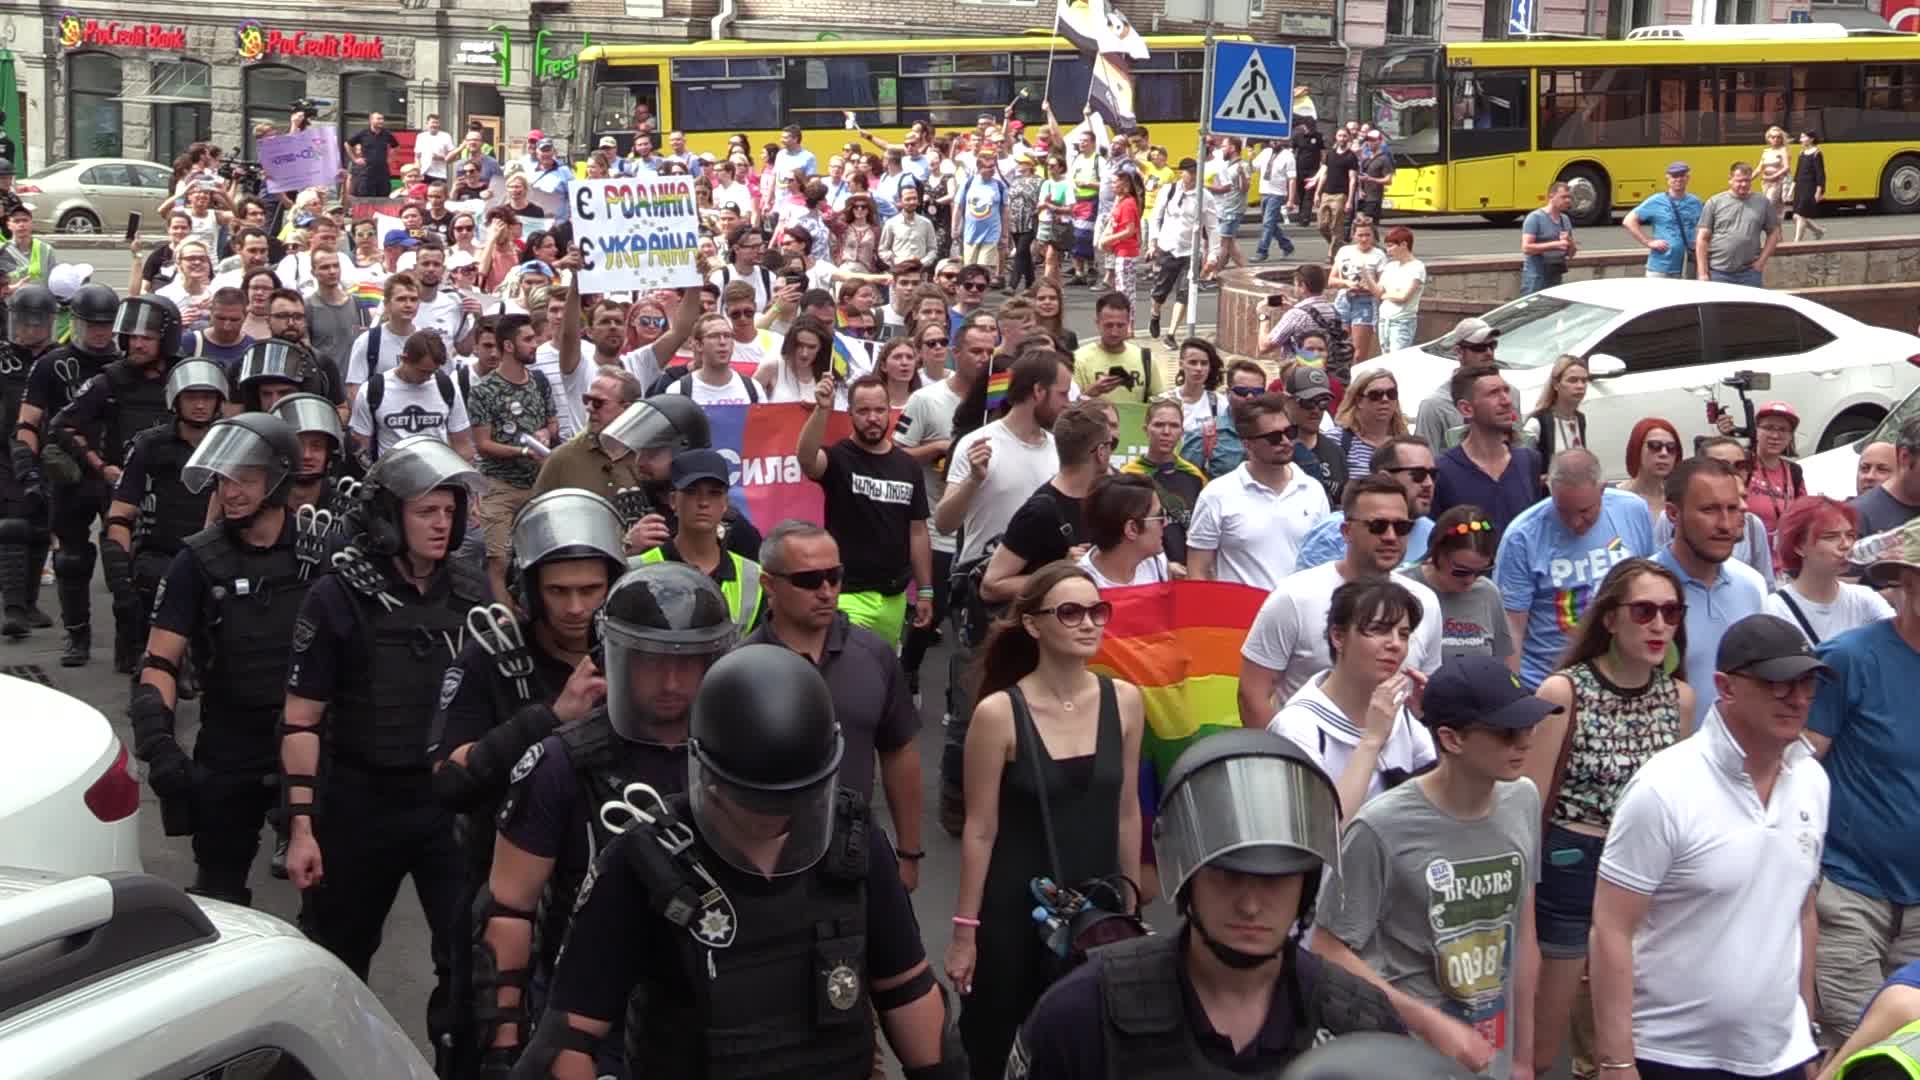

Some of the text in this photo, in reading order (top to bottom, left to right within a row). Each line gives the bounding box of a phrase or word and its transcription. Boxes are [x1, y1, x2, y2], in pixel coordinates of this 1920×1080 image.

[83, 19, 186, 48] ProCredit Bank
[267, 30, 384, 58] ProCredit Bank
[604, 182, 694, 219] РОДИНА
[598, 226, 698, 270] УКРАЇНА
[387, 415, 441, 427] GET TEST
